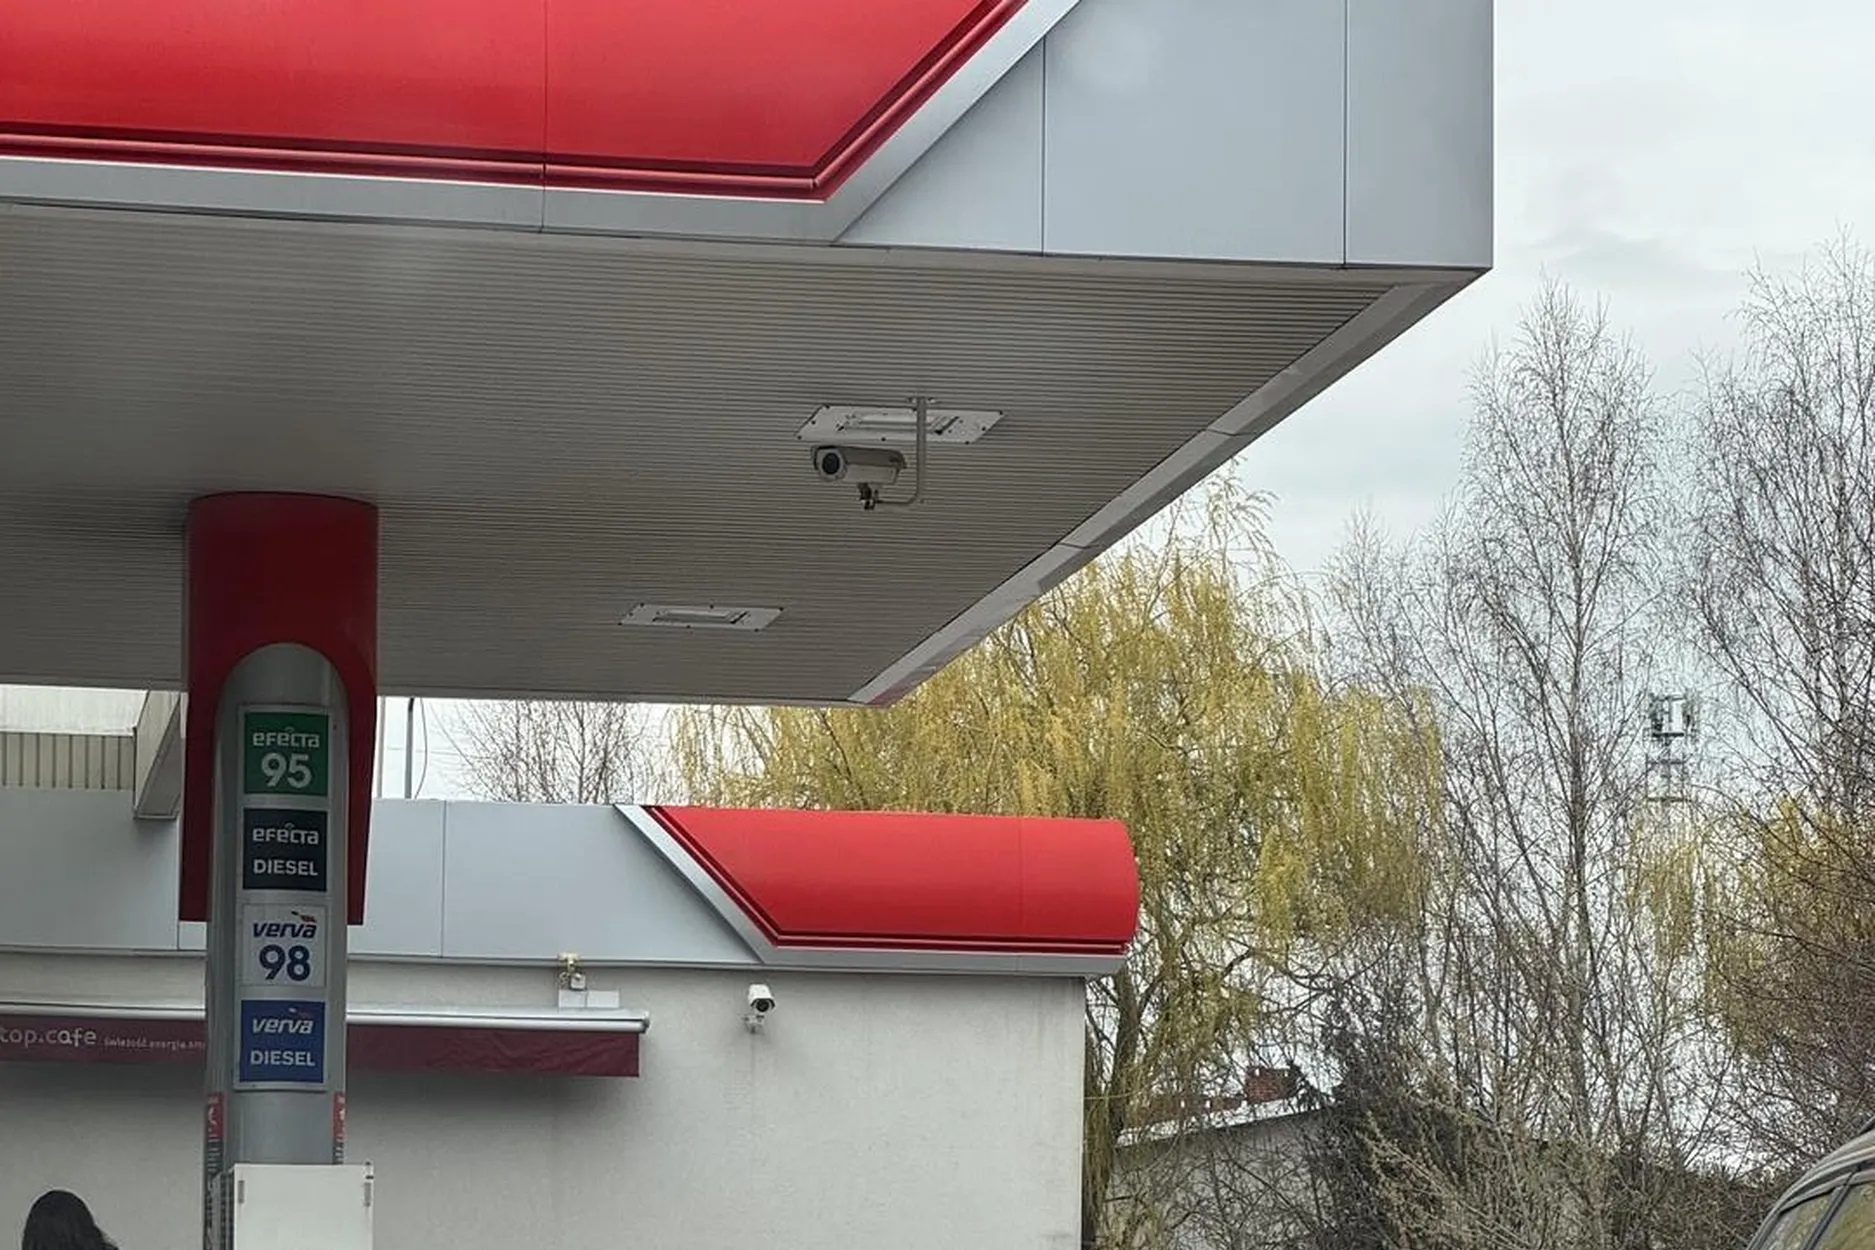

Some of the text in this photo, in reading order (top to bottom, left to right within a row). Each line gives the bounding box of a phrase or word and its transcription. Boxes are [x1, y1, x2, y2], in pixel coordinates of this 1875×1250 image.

[261, 752, 312, 789] 95
[253, 859, 319, 876] DIESEL
[252, 922, 318, 939] verva
[259, 944, 311, 982] 98
[251, 1018, 314, 1034] verva
[250, 1050, 316, 1066] DIESEL
